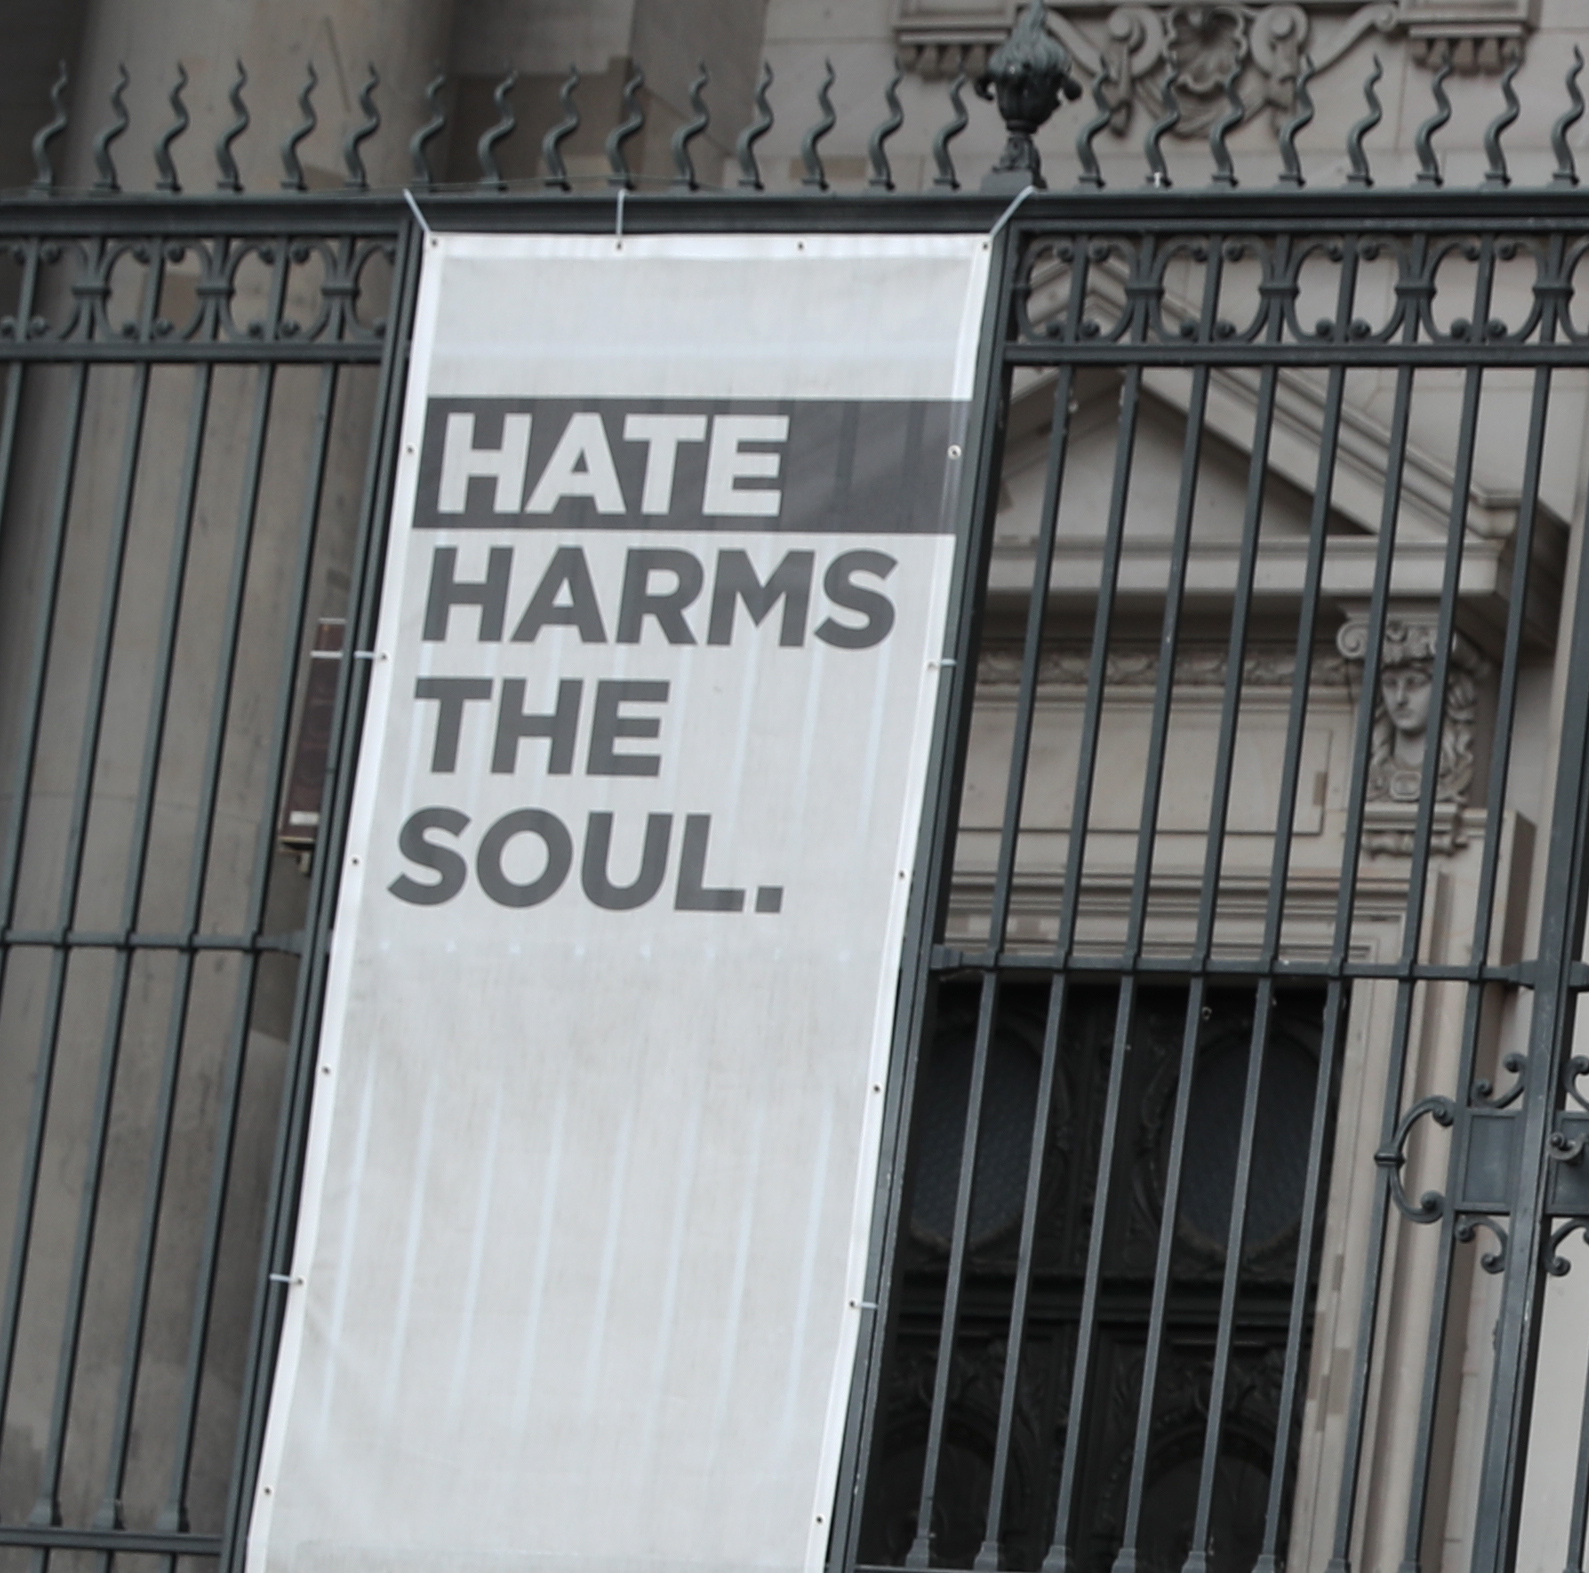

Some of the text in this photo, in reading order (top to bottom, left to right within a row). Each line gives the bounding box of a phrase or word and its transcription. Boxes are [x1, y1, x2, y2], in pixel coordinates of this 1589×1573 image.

[438, 412, 790, 517] HATE
[422, 544, 898, 649] HARMS
[414, 677, 670, 777] THE
[387, 805, 784, 914] SOUL.
